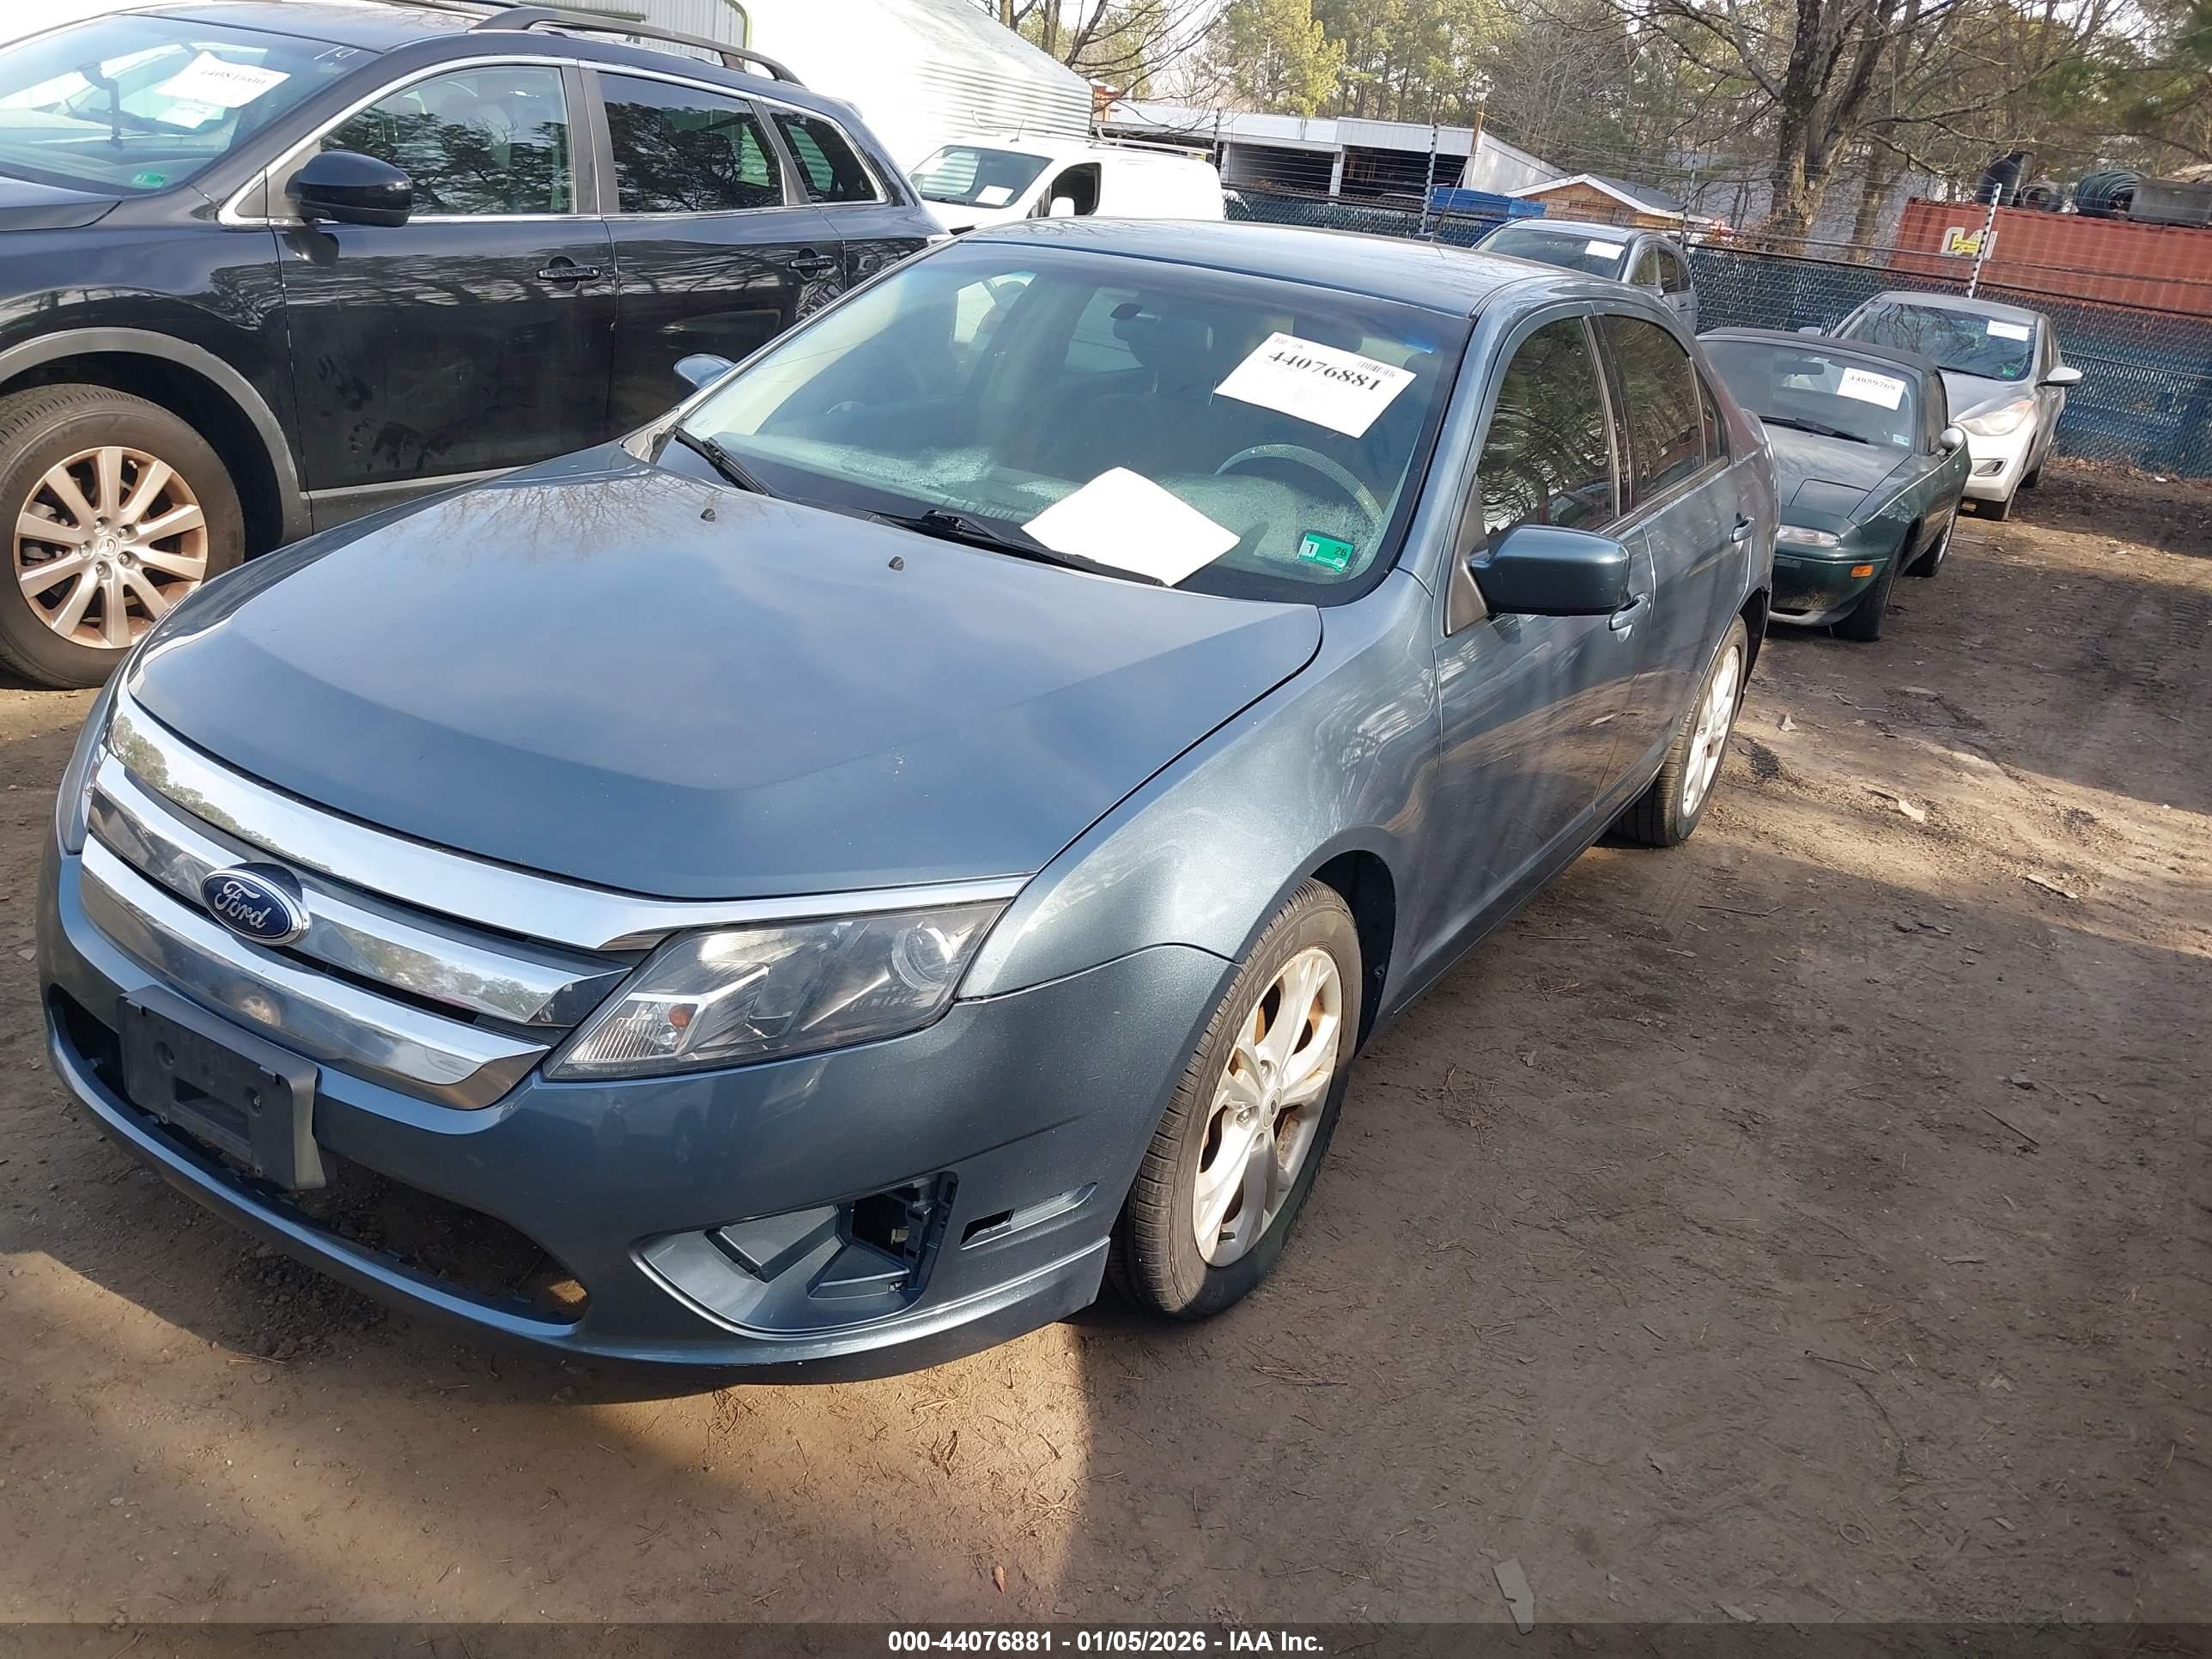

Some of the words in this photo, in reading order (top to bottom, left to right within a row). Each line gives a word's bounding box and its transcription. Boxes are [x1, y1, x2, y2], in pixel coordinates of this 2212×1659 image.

[1268, 350, 1382, 392] 44076881
[1307, 543, 1316, 555] 1
[1334, 546, 1348, 557] 26
[213, 880, 272, 929] Ford
